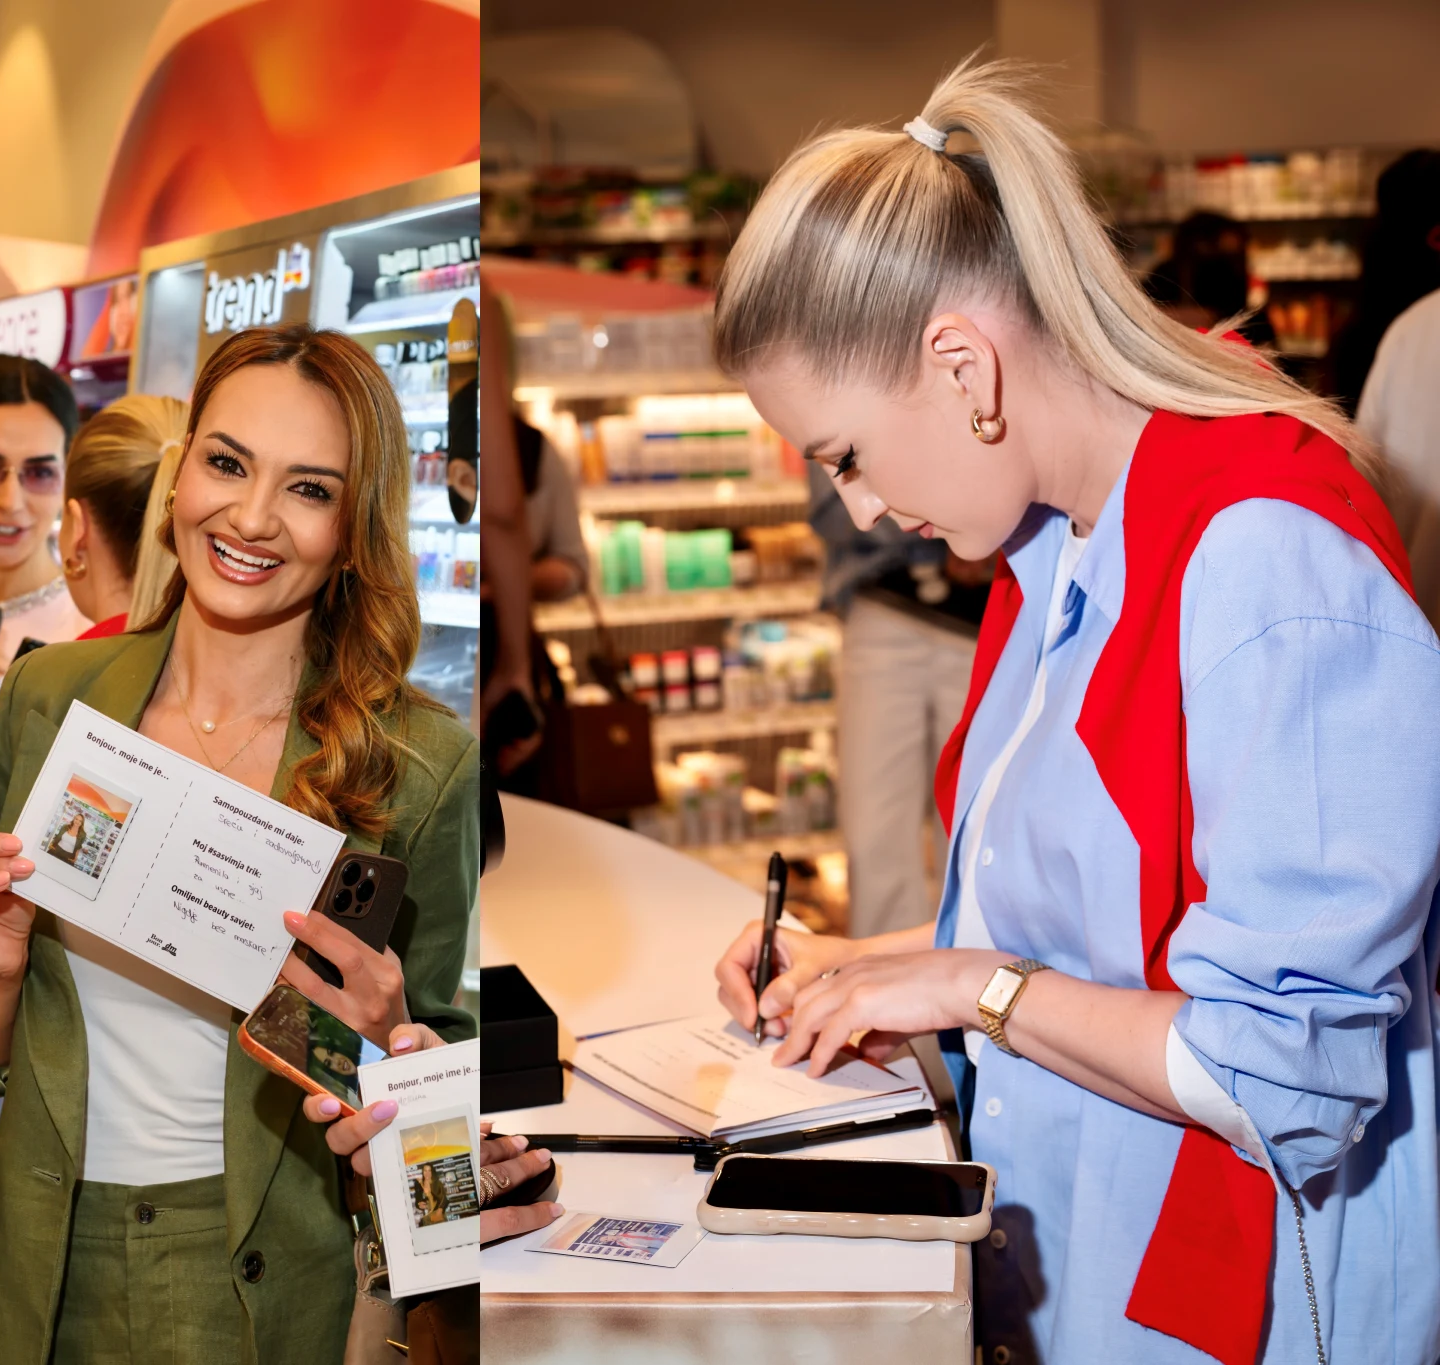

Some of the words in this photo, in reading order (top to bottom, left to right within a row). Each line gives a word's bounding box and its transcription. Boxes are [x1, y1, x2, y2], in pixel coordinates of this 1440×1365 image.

[87, 732, 116, 754] Bonjour,
[119, 751, 137, 763] moje
[139, 759, 153, 771] ime
[153, 767, 168, 780] je...
[213, 796, 273, 830] Samopouzdanje
[274, 827, 285, 836] mi
[285, 833, 304, 846] daje:
[193, 839, 208, 852] Moj
[208, 847, 244, 870] #sasvimja
[246, 866, 261, 878] trik:
[172, 885, 203, 905] Omiljeni
[203, 900, 229, 919] beauty
[230, 916, 254, 931] savjet:
[151, 934, 163, 943] Bon
[388, 1079, 421, 1091] Bonjour,
[424, 1072, 443, 1083] moje
[446, 1069, 461, 1078] ime
